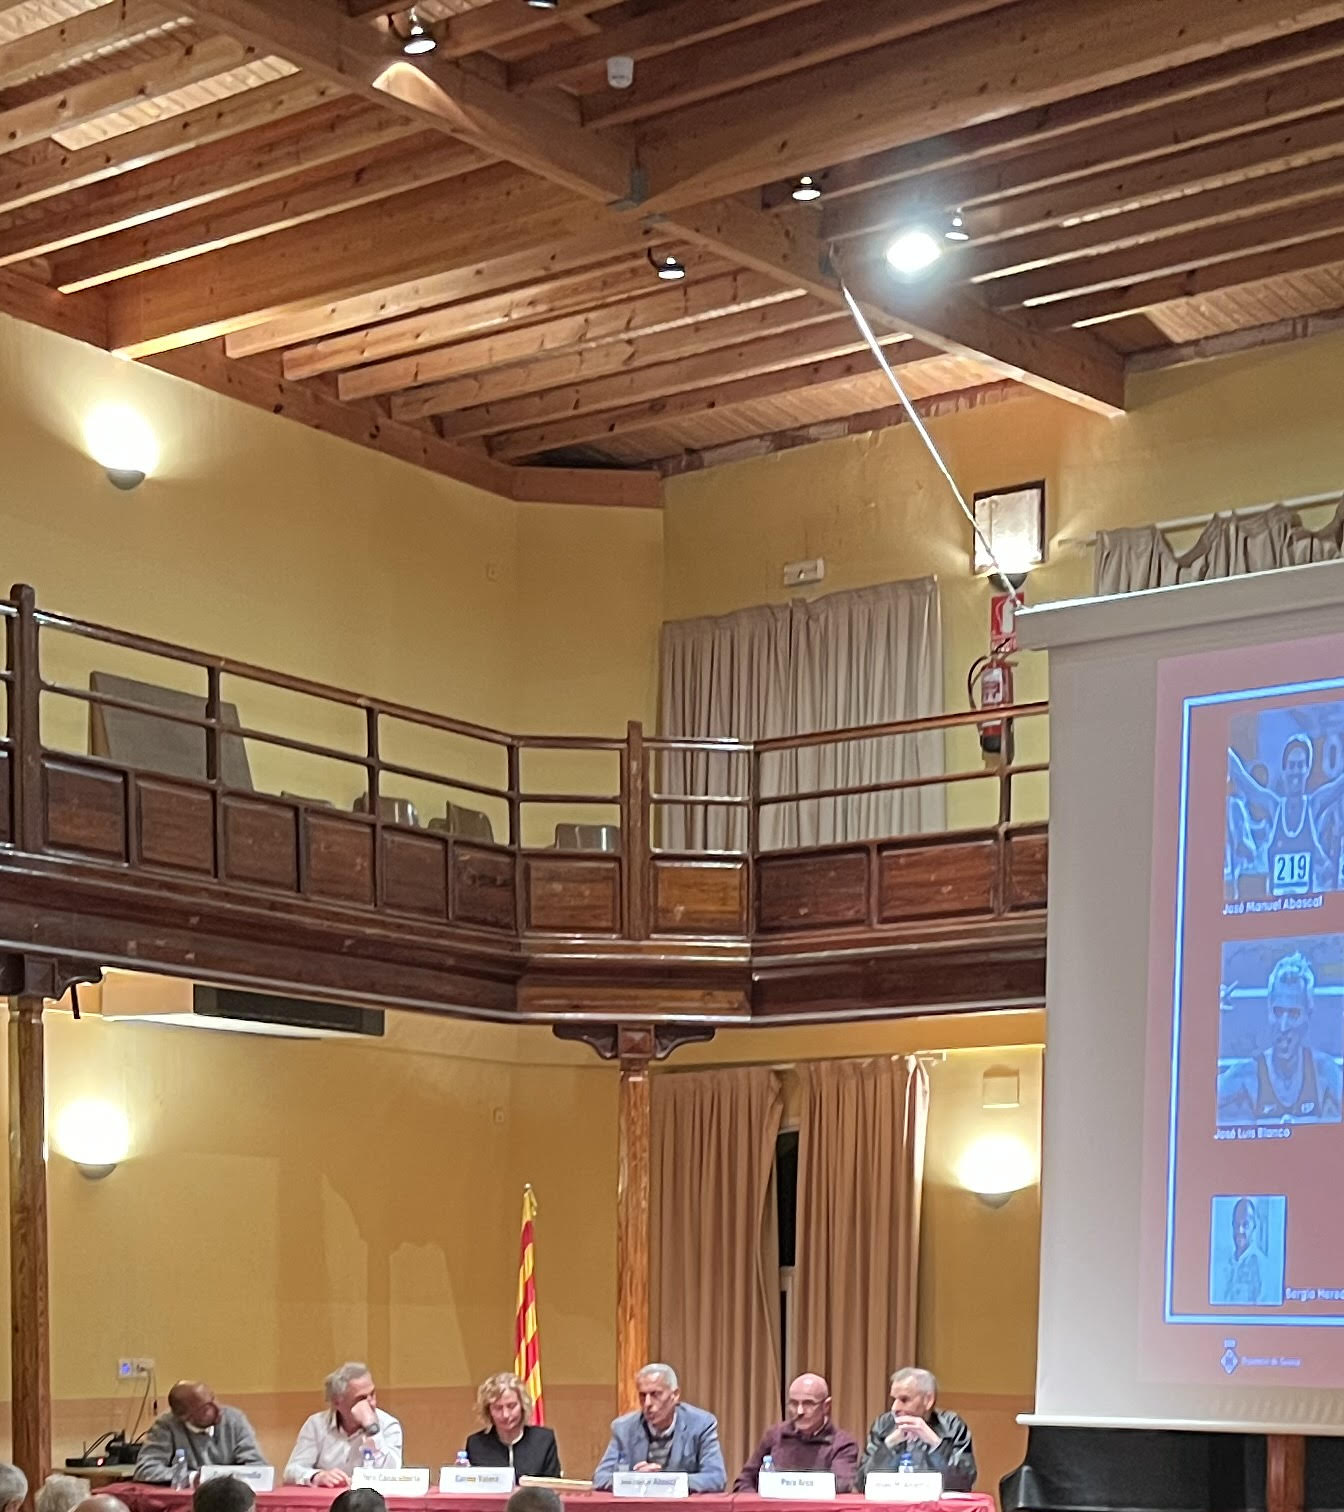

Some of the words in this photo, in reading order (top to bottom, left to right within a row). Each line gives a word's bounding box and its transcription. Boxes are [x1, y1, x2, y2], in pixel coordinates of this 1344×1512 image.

[1276, 854, 1307, 881] 219
[1246, 900, 1281, 913] Manuel
[1283, 895, 1324, 910] Abascal
